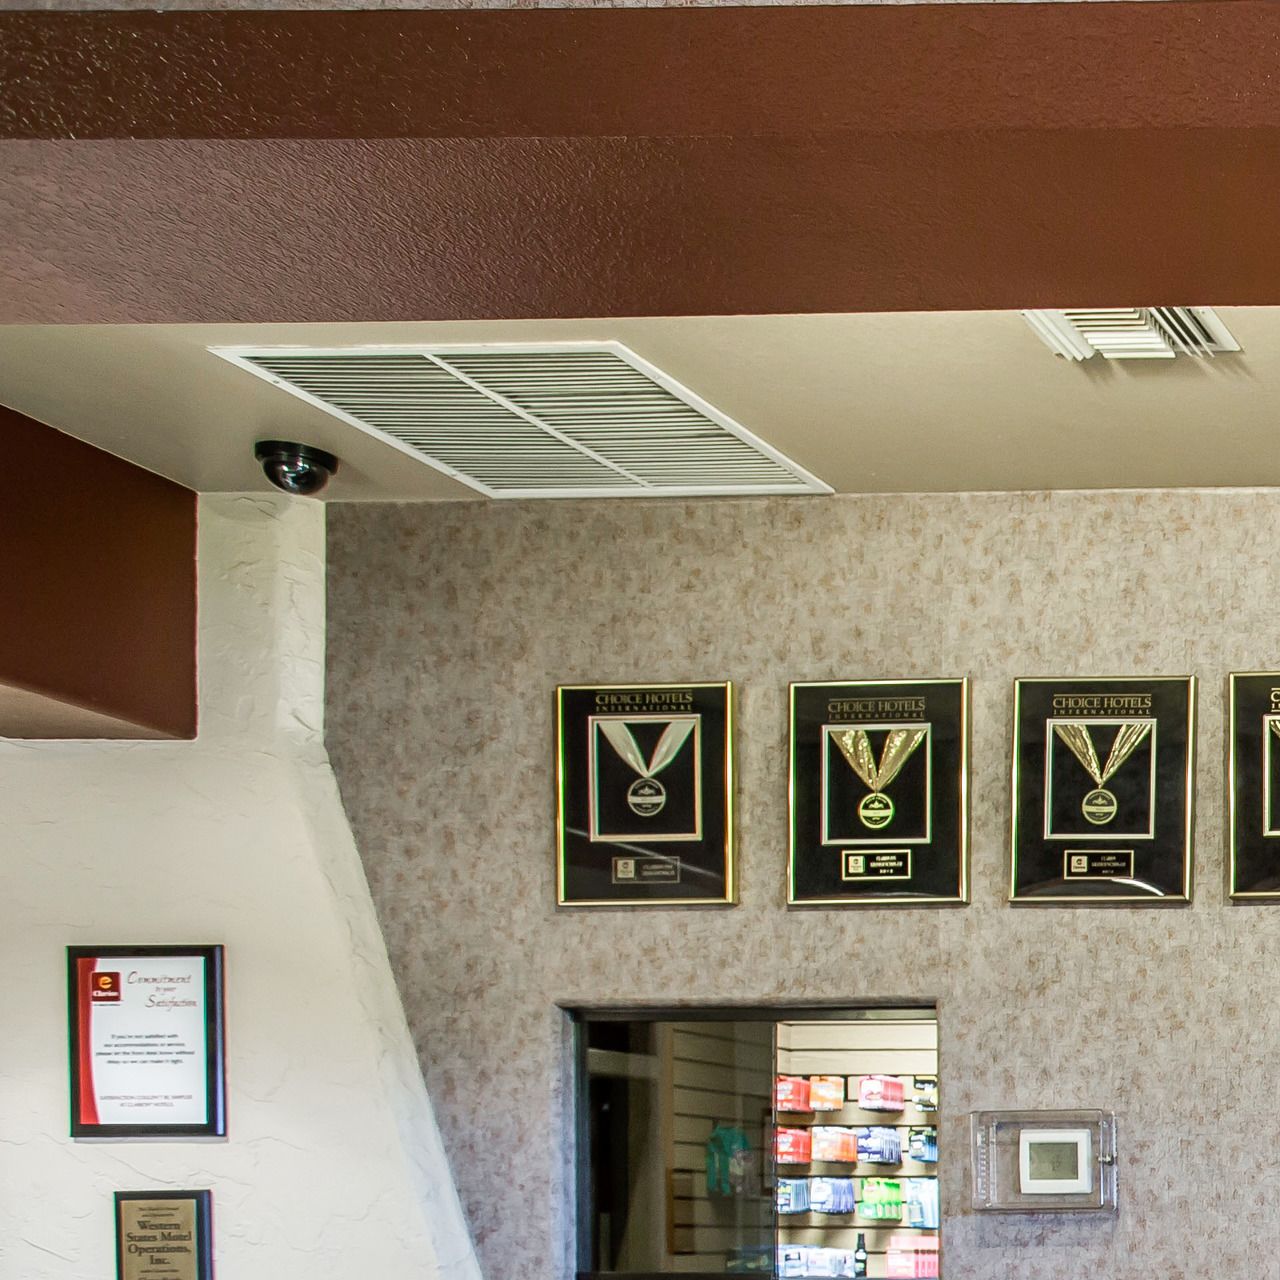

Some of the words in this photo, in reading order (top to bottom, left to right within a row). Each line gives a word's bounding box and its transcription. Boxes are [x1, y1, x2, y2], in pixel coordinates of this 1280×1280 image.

[595, 693, 643, 705] CHOICE
[646, 693, 693, 704] HOTELS
[1053, 697, 1101, 709] CHOICE
[1104, 697, 1152, 708] HOTELS
[828, 702, 875, 713] CHOICE
[878, 700, 926, 712] HOTELS
[127, 971, 192, 984] Commitment
[145, 994, 198, 1011] Satisfaction
[136, 1220, 180, 1230] Western
[126, 1232, 157, 1242] States
[160, 1231, 192, 1241] Motel
[149, 1255, 170, 1265] Inc.
